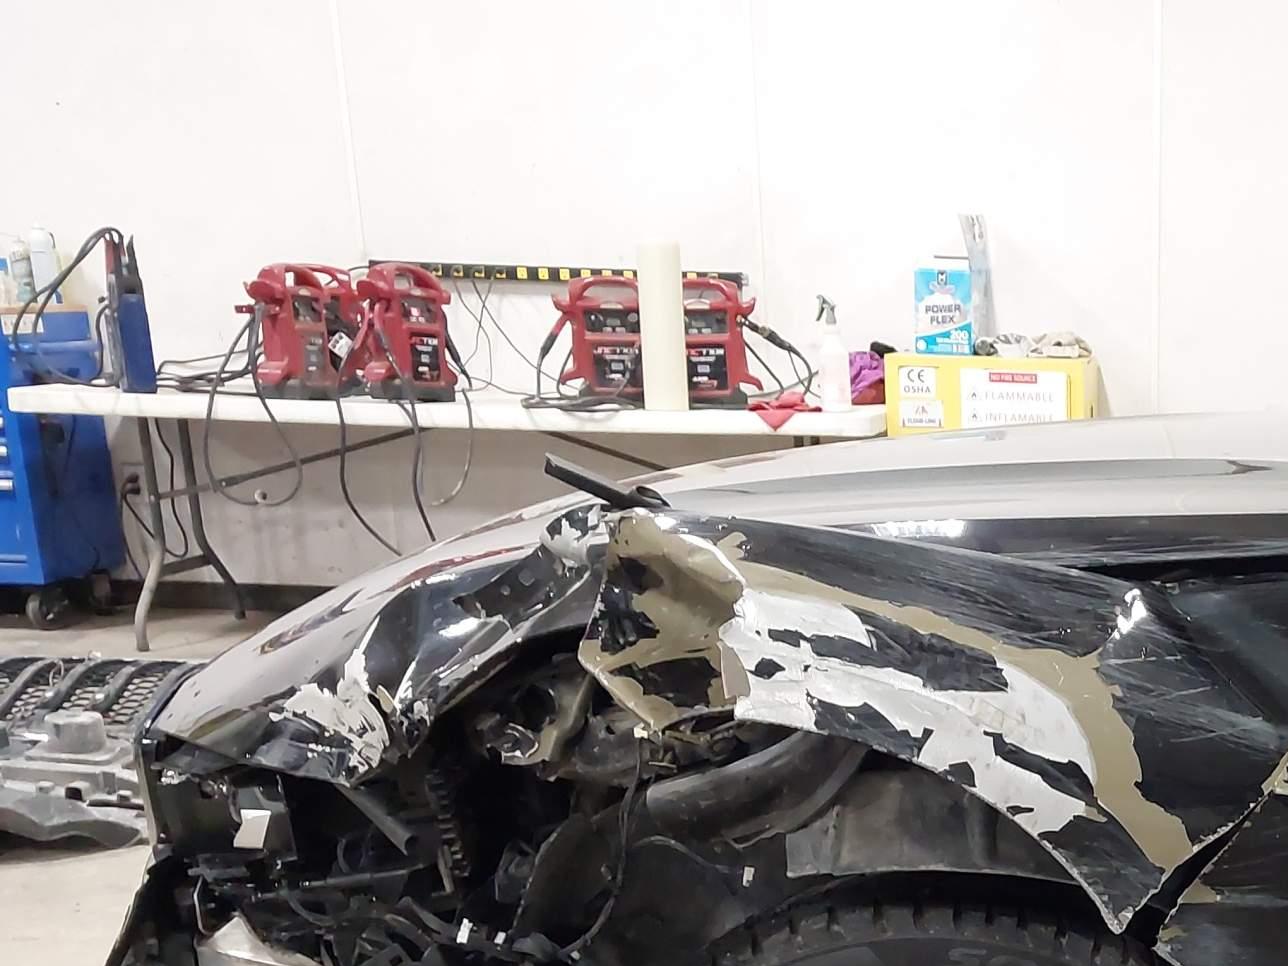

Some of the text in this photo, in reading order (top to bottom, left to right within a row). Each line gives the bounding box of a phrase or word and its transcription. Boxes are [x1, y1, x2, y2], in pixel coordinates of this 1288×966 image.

[925, 304, 961, 314] POWER
[930, 315, 956, 325] FLEX
[907, 368, 925, 383] CE
[903, 385, 932, 393] OSHA
[984, 391, 1054, 402] FLAMMABLE
